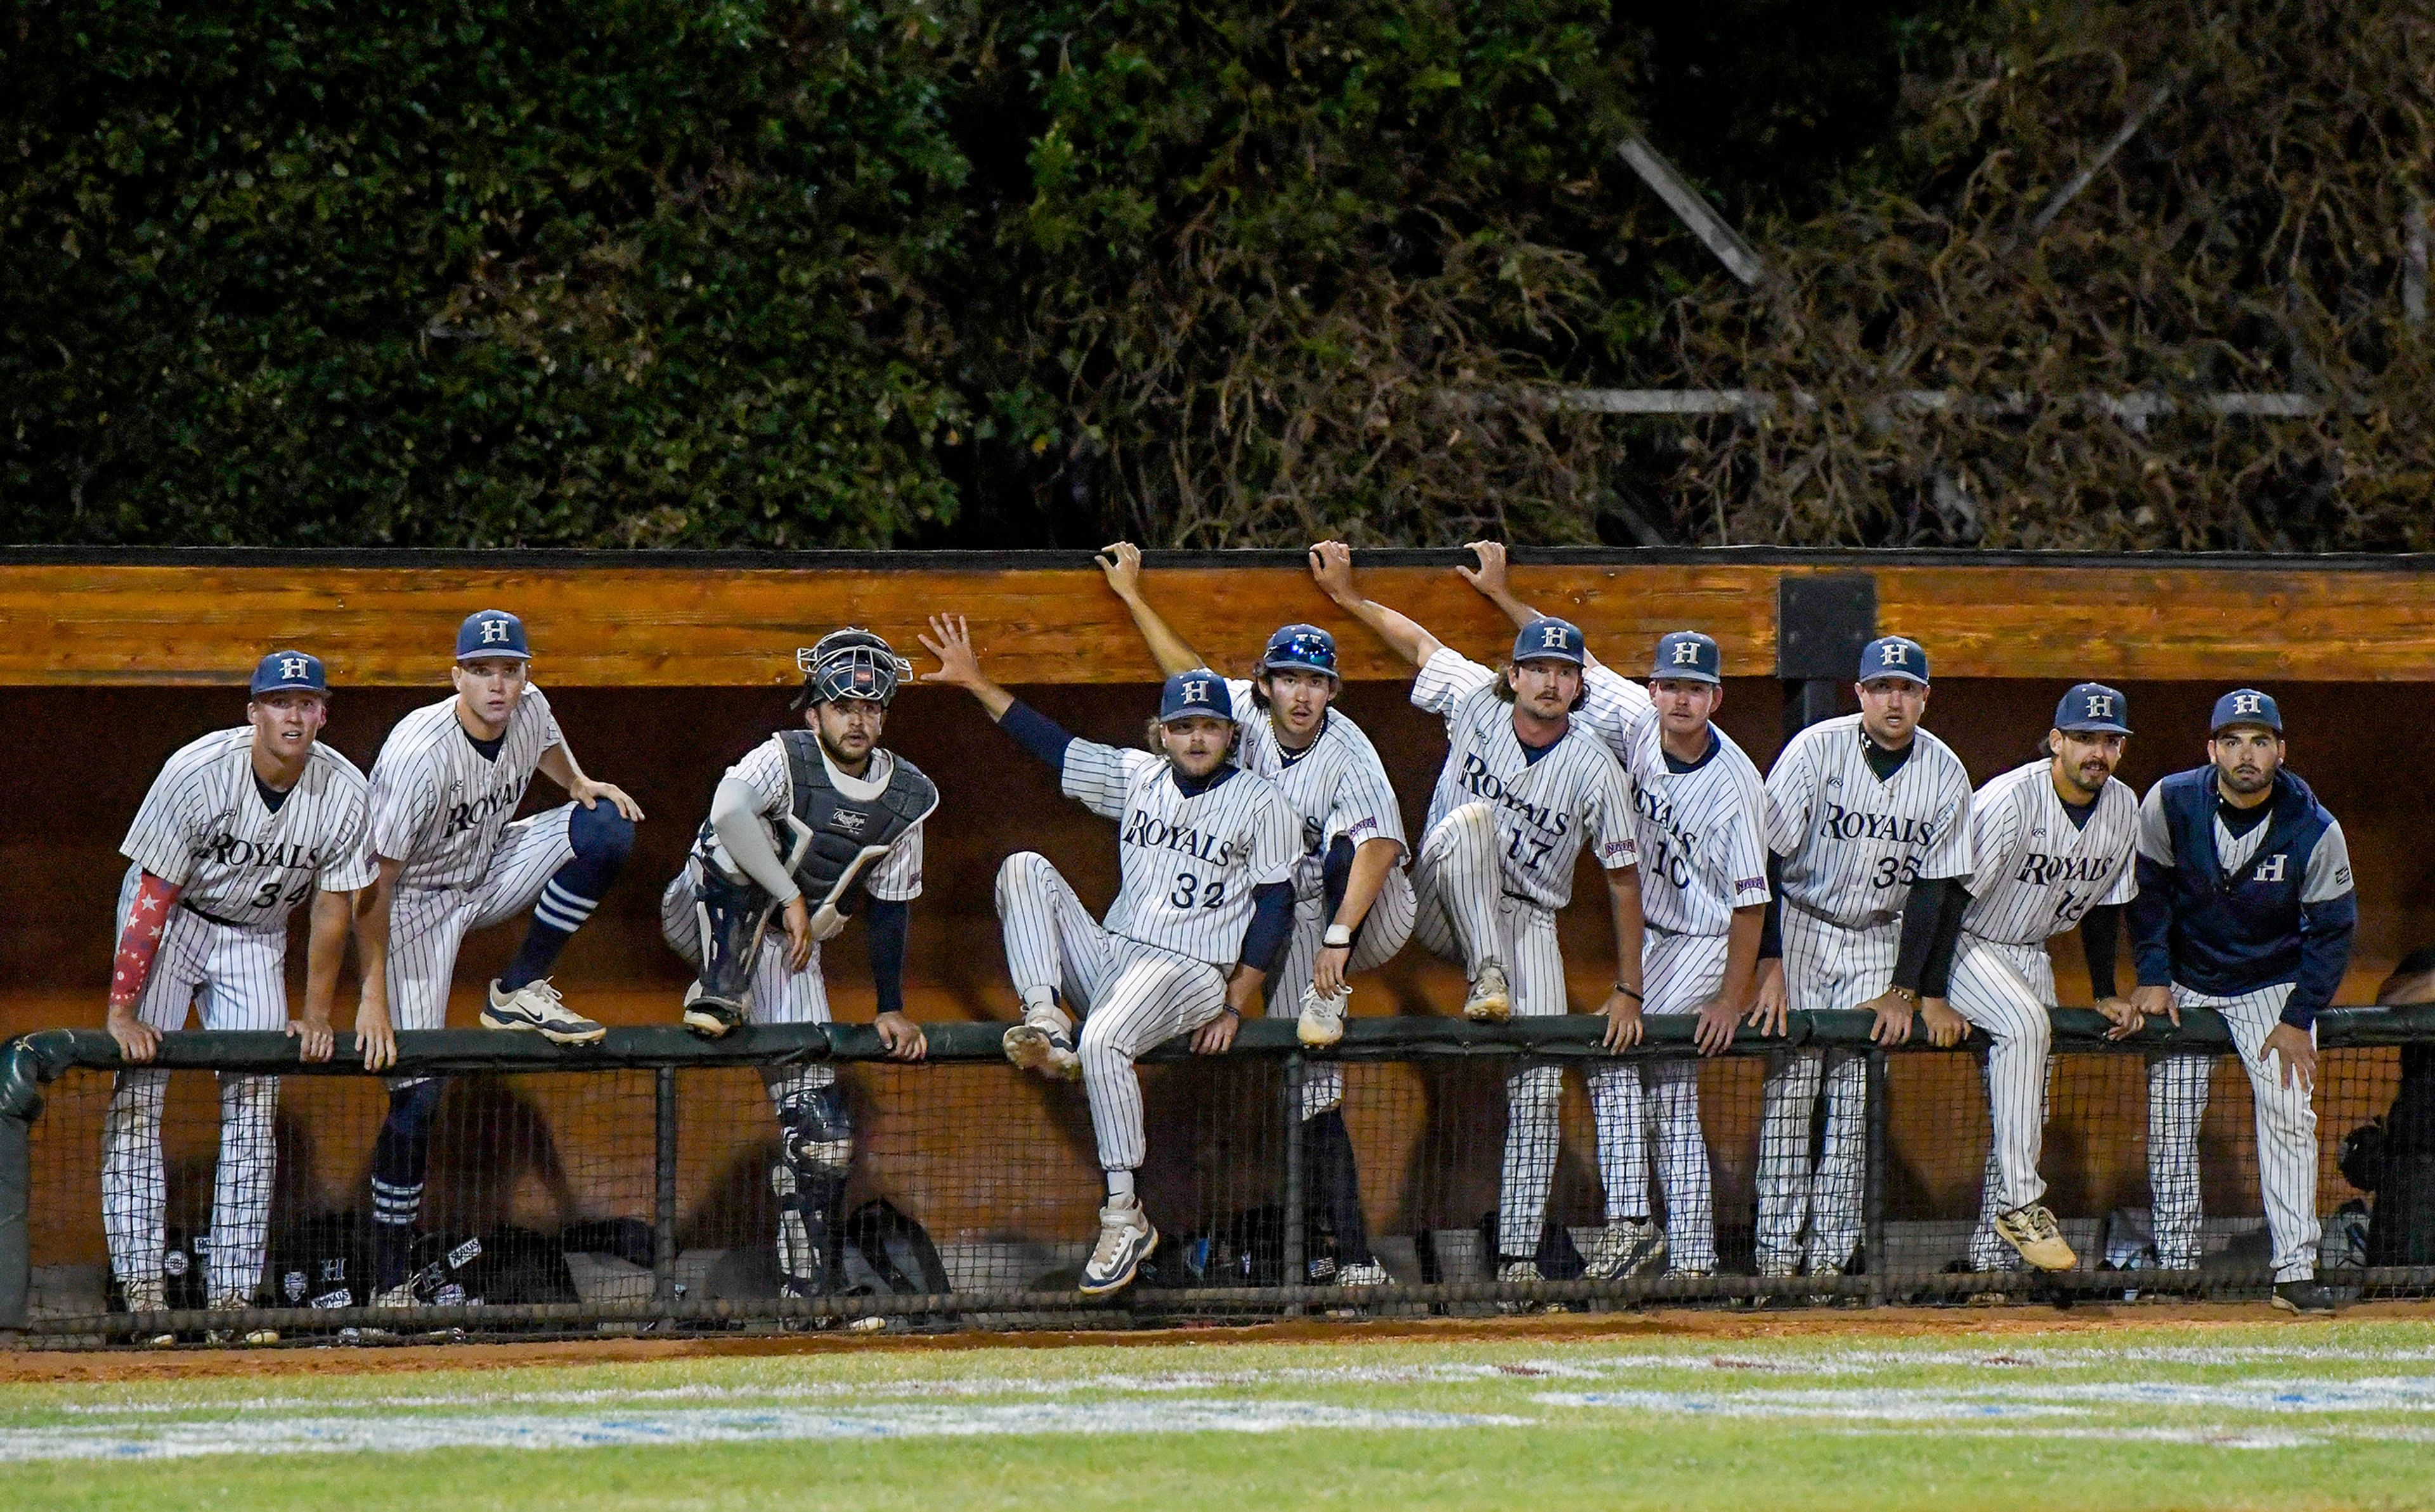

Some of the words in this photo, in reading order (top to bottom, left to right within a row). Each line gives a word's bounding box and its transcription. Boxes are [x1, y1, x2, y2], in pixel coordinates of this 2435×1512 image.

[480, 620, 509, 643] H
[1542, 627, 1568, 649] H
[1672, 642, 1700, 664] H
[1880, 644, 1907, 666] H
[280, 658, 309, 680] H
[1181, 680, 1209, 704] H
[2086, 695, 2113, 717] H
[2233, 695, 2261, 714] H
[1631, 773, 1697, 855] OYALS
[1820, 801, 1935, 846] ROYALS
[1122, 808, 1235, 867] ROYALS
[1507, 827, 1555, 870] 17
[1652, 841, 1690, 889] 10
[1873, 856, 1923, 889] 35
[2015, 853, 2113, 886] ROYALS
[2253, 854, 2288, 882] H
[251, 880, 312, 908] 34
[1171, 872, 1225, 909] 32
